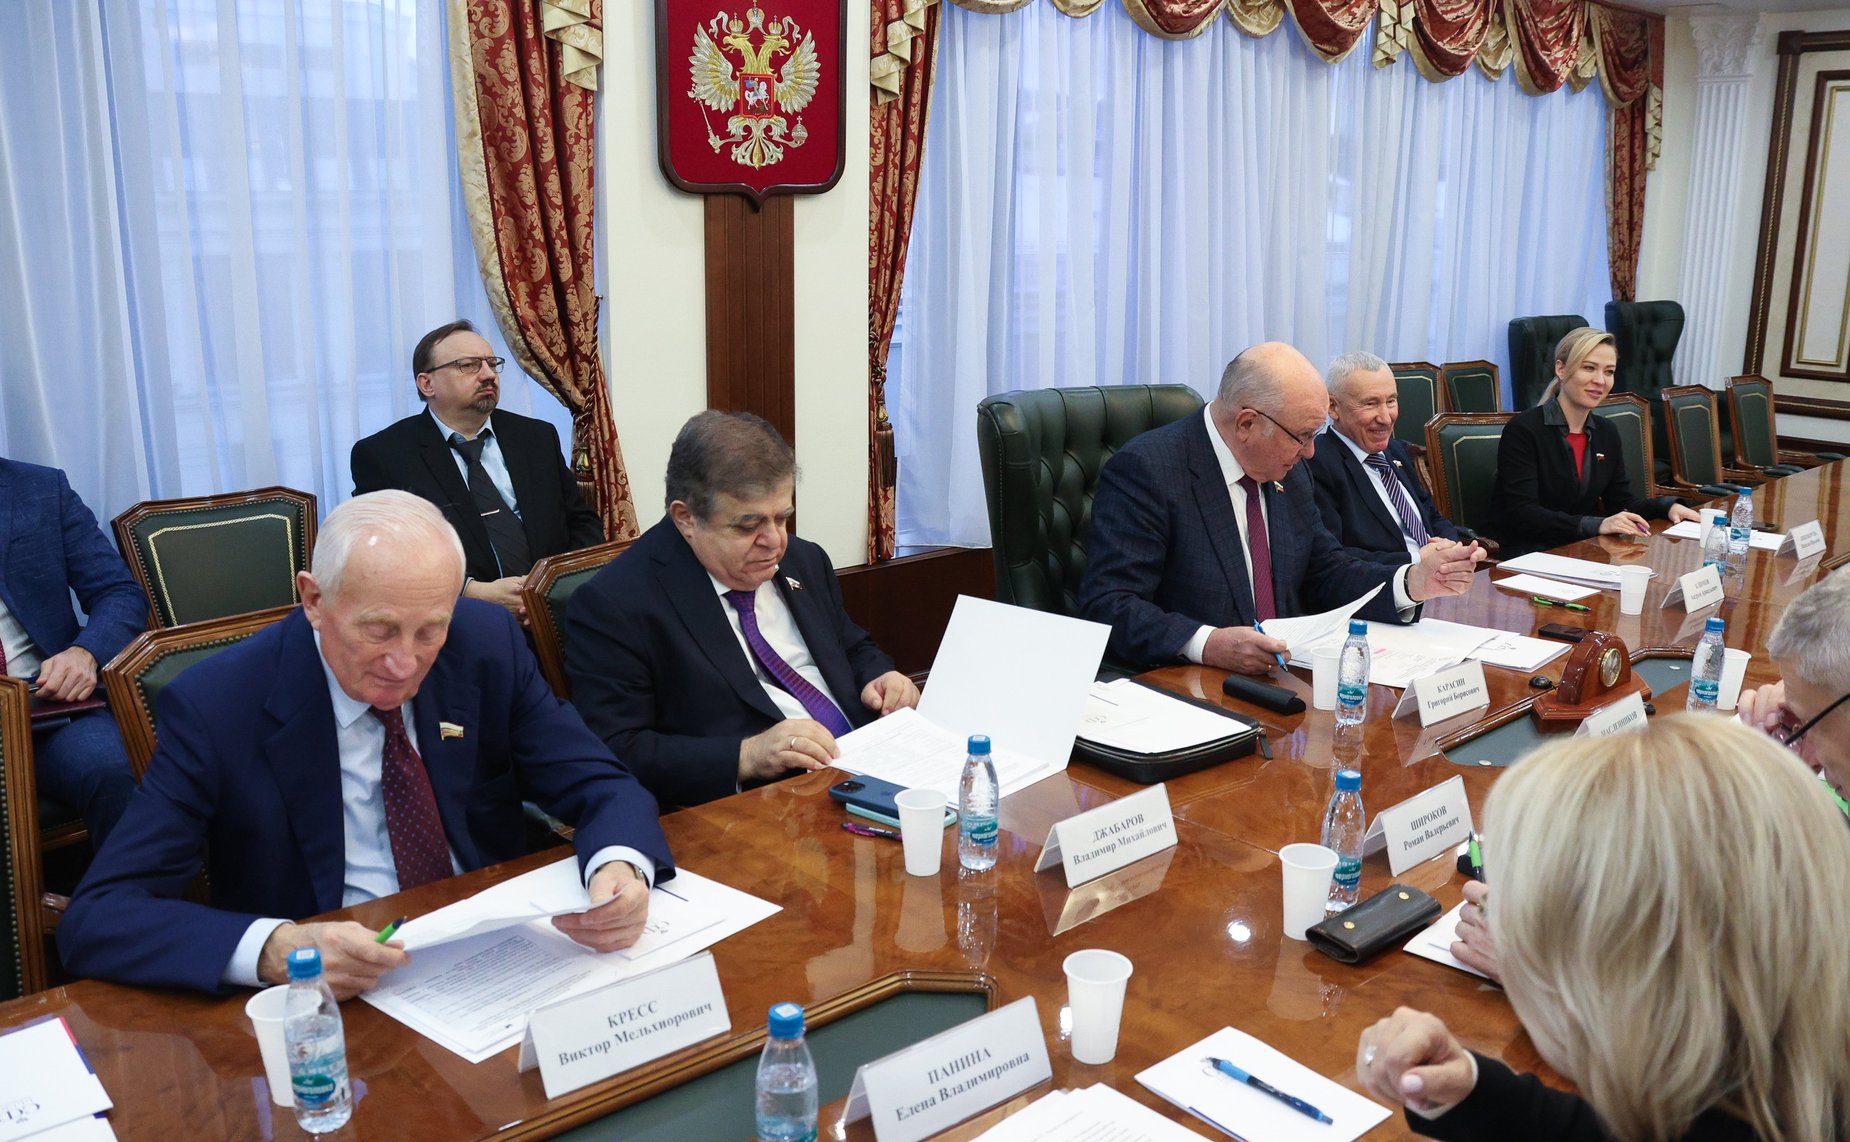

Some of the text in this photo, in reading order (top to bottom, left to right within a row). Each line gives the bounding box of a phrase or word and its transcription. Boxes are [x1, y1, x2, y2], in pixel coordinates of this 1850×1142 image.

[1427, 687, 1480, 709] Григорий Борисович
[1437, 678, 1466, 693] КАРАСИН
[1093, 813, 1144, 843] ДЖАБАРОВ
[1403, 816, 1460, 851] Роман Валерьевич
[1410, 805, 1447, 831] ШИРОКОВ
[1073, 822, 1168, 865] Владимир Михайлович
[607, 1000, 659, 1029] КРЕСС
[558, 1002, 713, 1066] Виктор Мельхиорович
[927, 1047, 992, 1085] ПАНИНА
[895, 1052, 1030, 1122] Елена Владимировна
